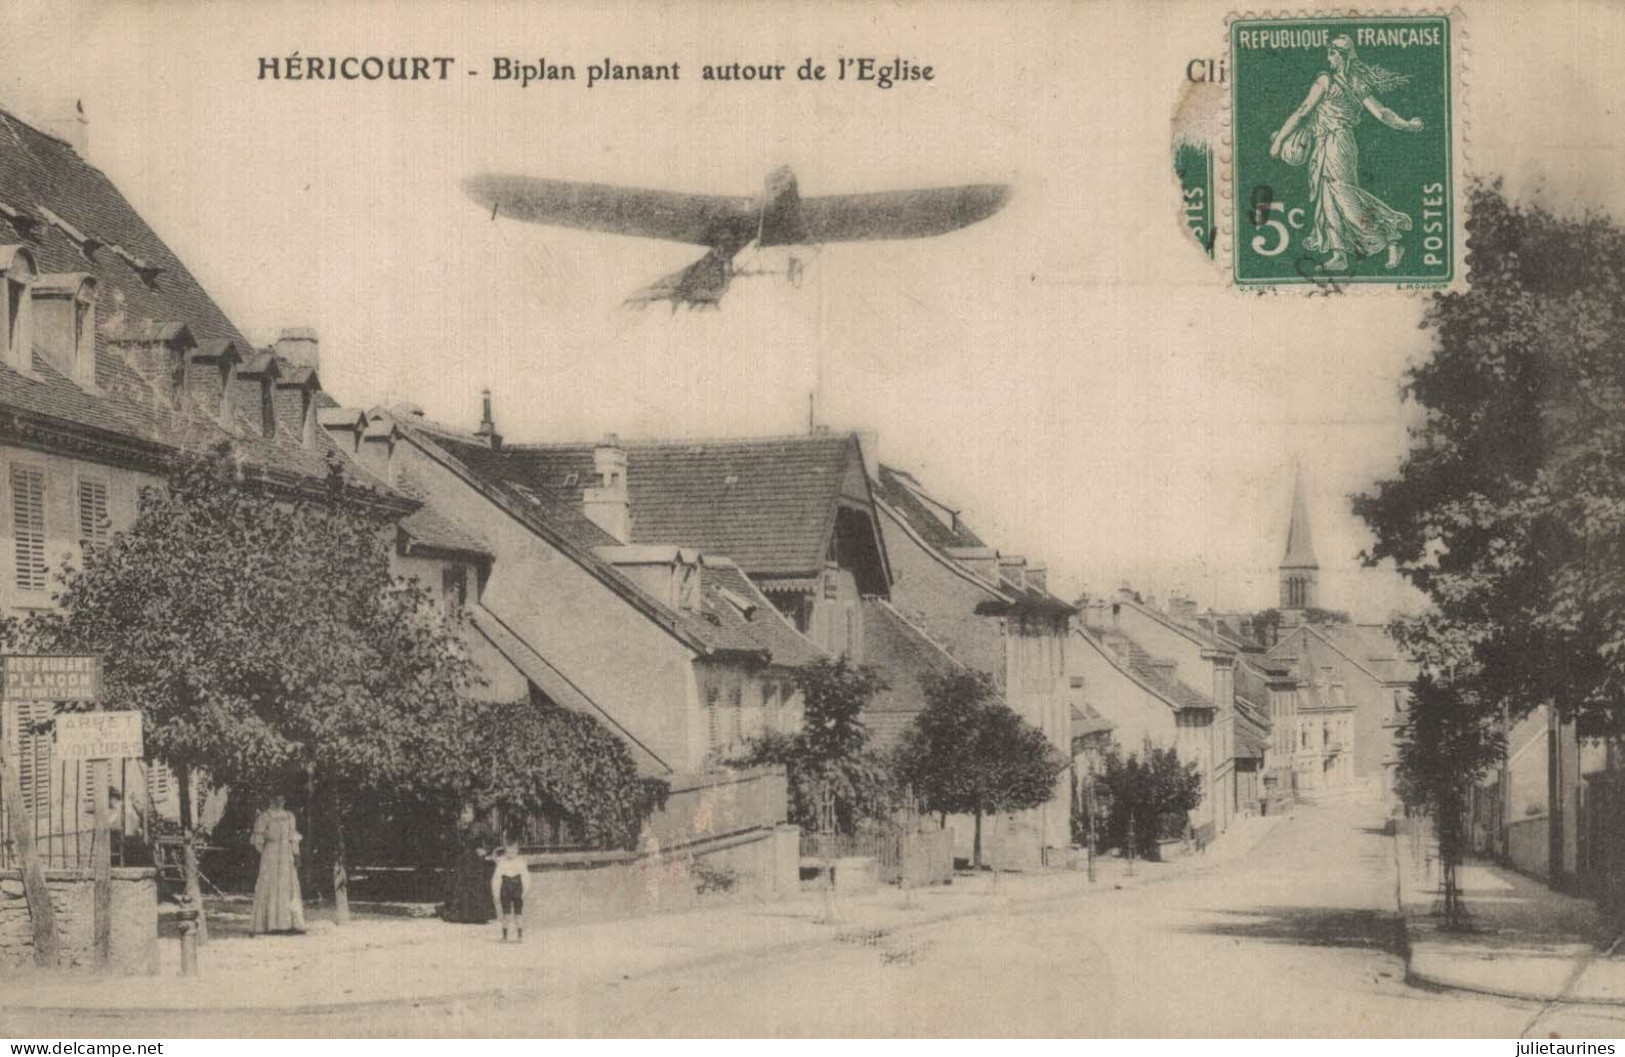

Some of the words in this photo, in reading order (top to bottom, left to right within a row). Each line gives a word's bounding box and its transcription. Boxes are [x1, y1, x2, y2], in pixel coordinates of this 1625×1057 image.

[1240, 29, 1329, 50] REPUBLIQUE
[1357, 28, 1440, 49] FRANÇAISE
[1423, 182, 1443, 266] POSTES
